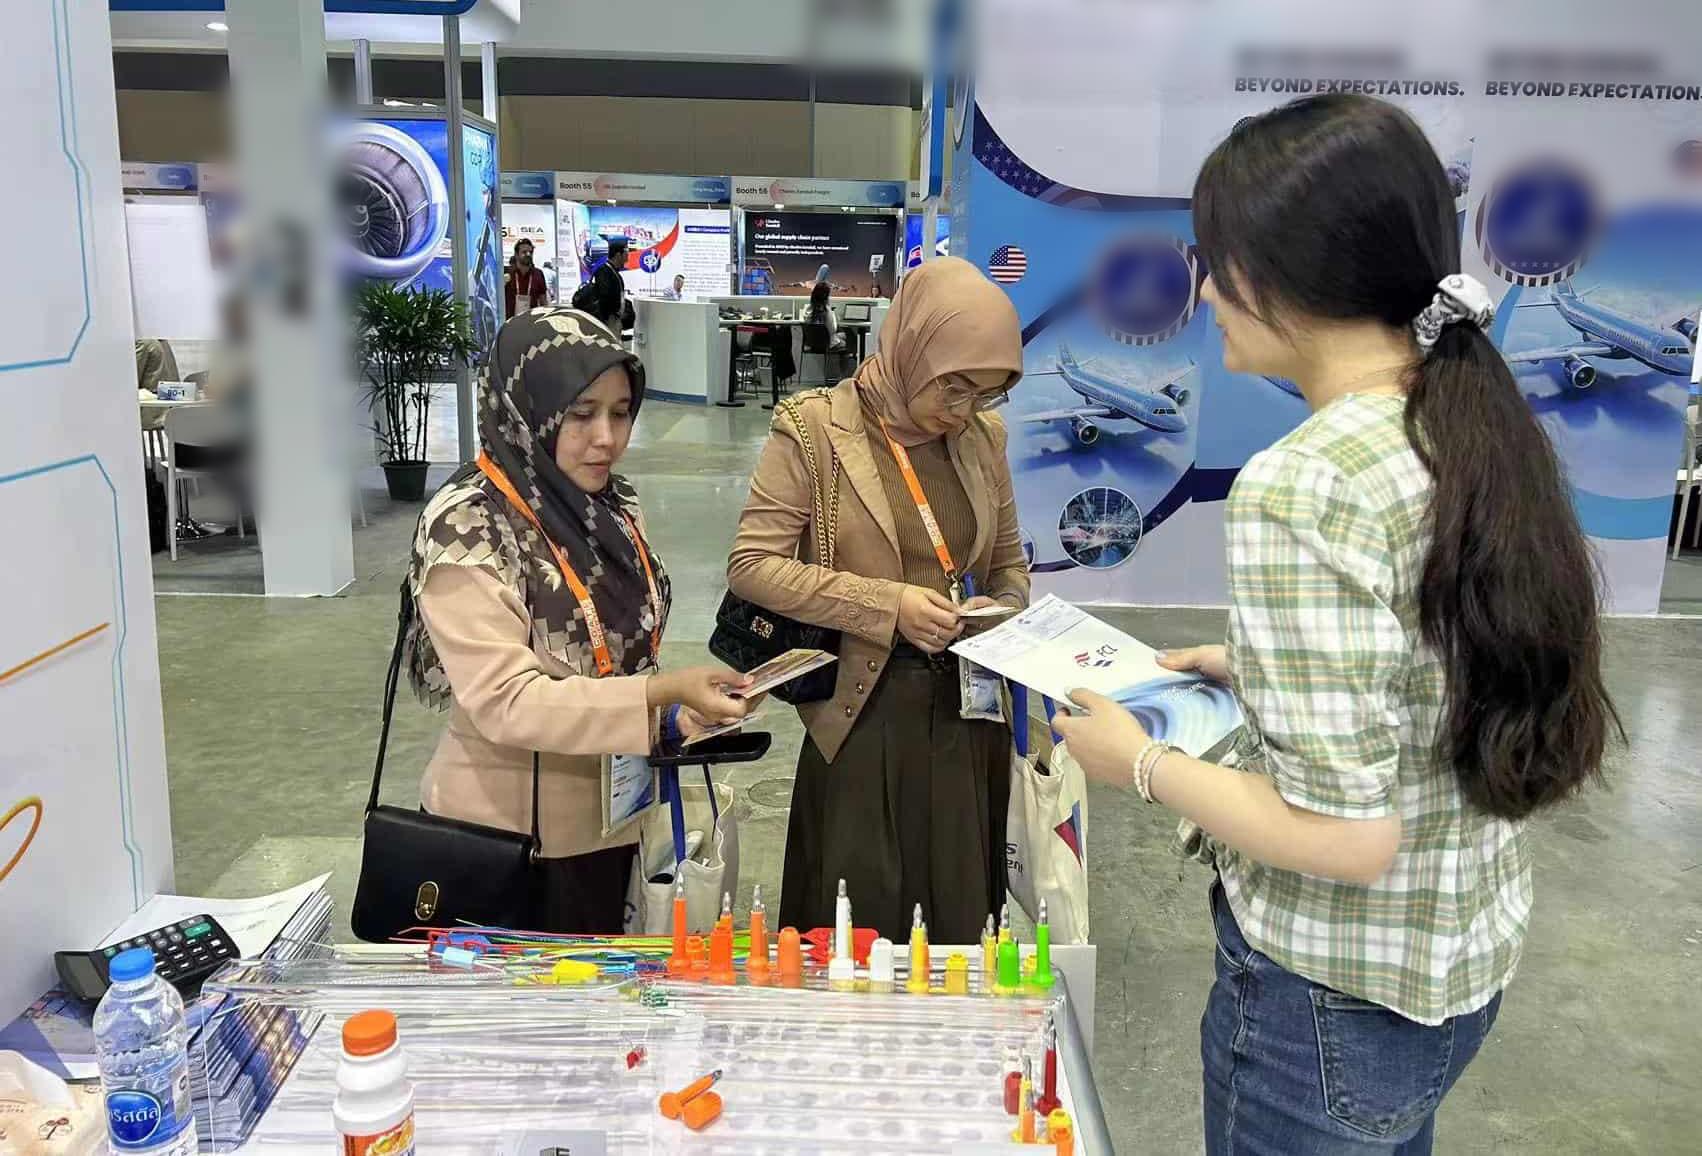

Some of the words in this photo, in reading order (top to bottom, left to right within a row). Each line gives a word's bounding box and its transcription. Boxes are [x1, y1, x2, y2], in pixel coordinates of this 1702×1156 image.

[1234, 77, 1312, 93] BEYOND
[1316, 79, 1465, 97] EXPECTATIONS.
[1485, 81, 1564, 97] BEYOND
[1568, 83, 1702, 100] EXPECTATION
[559, 182, 581, 190] Booth
[736, 187, 757, 195] Booth
